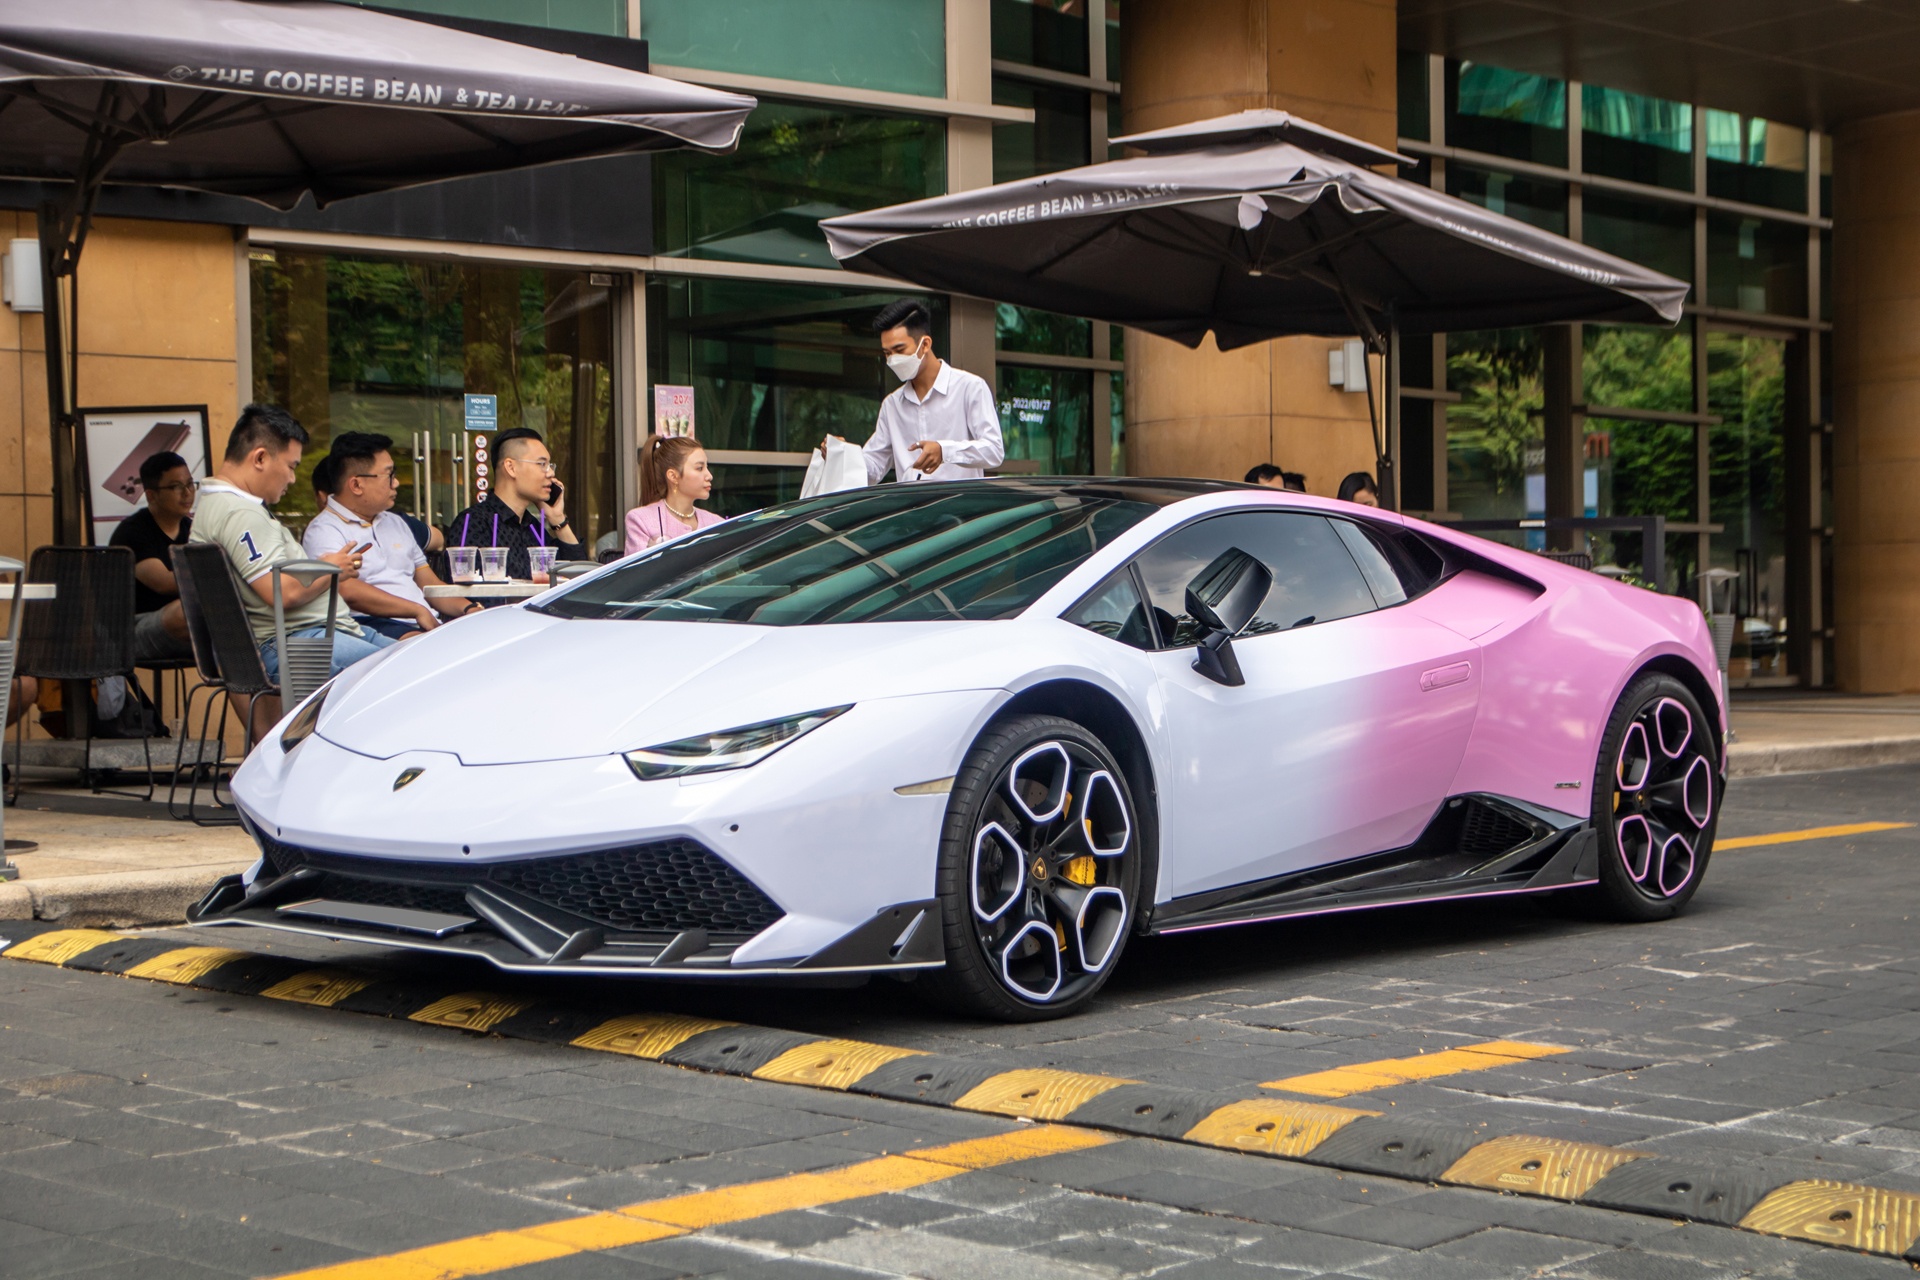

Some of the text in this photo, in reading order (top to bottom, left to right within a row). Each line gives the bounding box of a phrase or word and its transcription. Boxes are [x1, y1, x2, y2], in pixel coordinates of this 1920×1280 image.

[264, 70, 364, 97] COFFEE
[373, 78, 442, 105] BEAN
[453, 88, 469, 106] &
[474, 90, 516, 110] TEA
[976, 205, 1035, 227] COFFEE
[1041, 195, 1084, 217] BEAN
[1092, 192, 1104, 207] &
[1105, 188, 1138, 205] TEA
[470, 397, 491, 405] HOURS
[239, 530, 263, 563] 1
